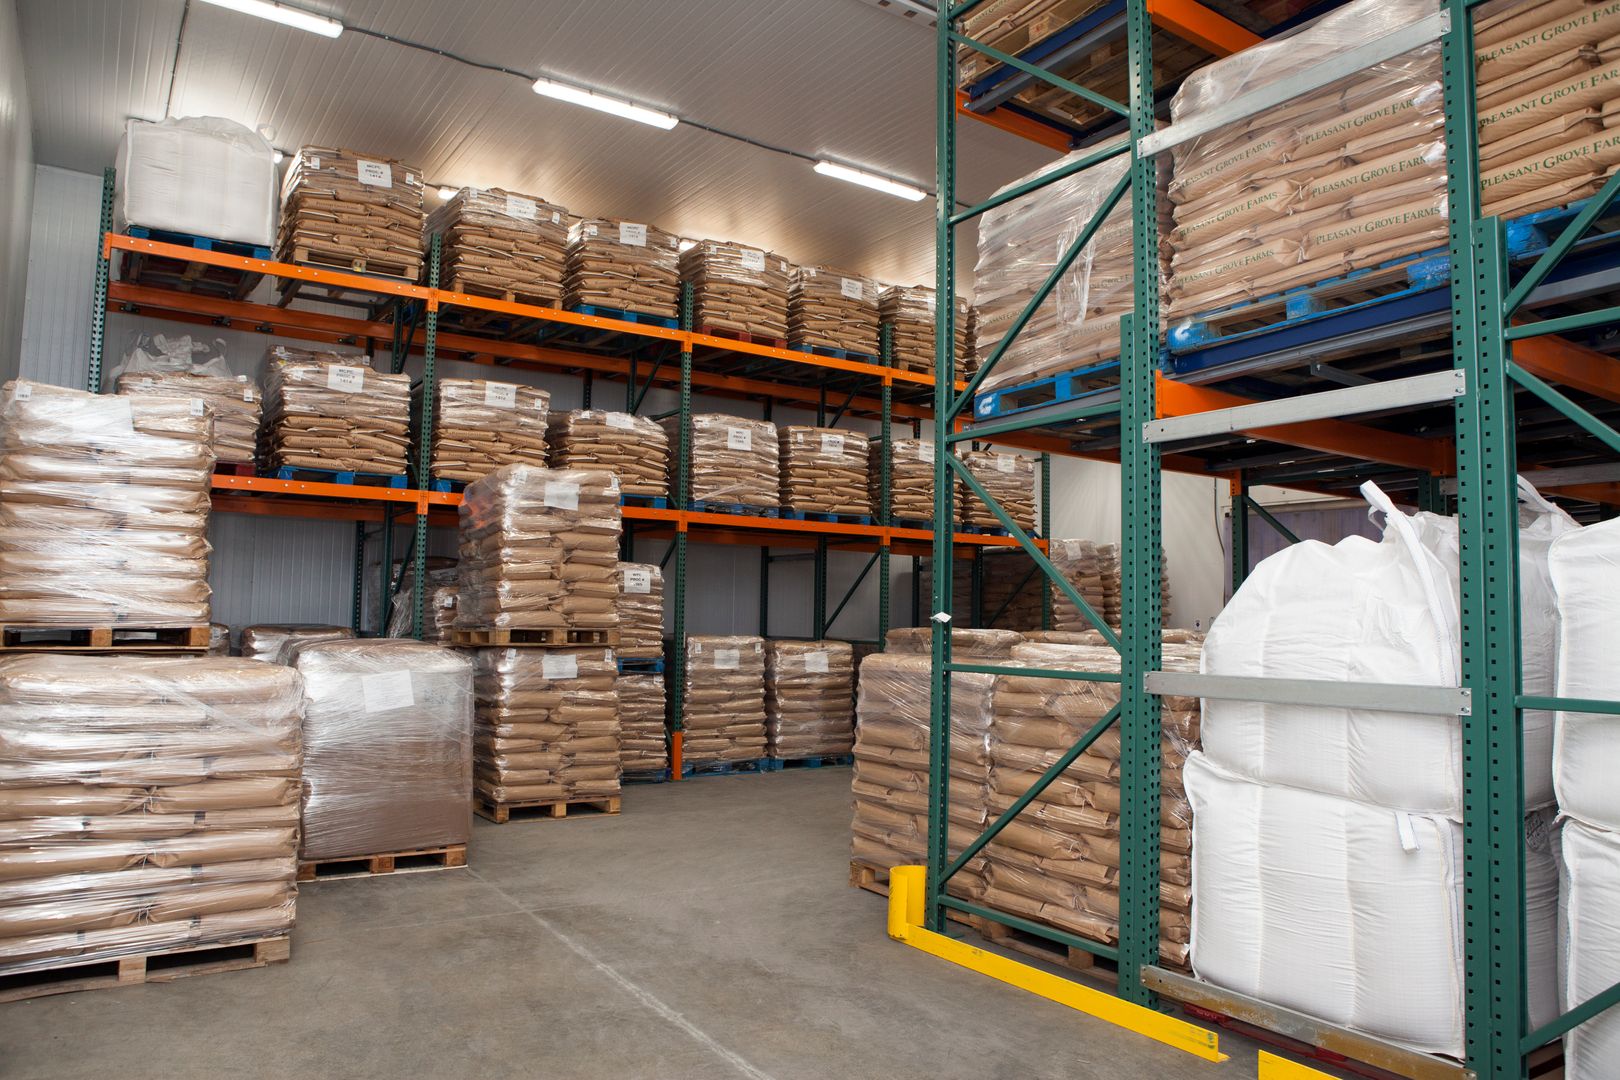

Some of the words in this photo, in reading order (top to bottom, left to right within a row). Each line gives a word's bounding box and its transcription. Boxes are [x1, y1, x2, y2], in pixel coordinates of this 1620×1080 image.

[1479, 34, 1539, 65] PLEASANT
[1541, 15, 1589, 42] GROVE
[1480, 98, 1538, 128] PLEASANT
[1540, 82, 1589, 105] GROVE
[1304, 119, 1353, 144] PLEASANT
[1353, 108, 1390, 127] GROVE
[1215, 152, 1244, 172] GROVE
[1244, 139, 1278, 157] FARMS
[1480, 162, 1540, 191] PLEASANT
[1543, 145, 1590, 169] GROVE
[1312, 175, 1360, 198] PLEASANT
[1360, 163, 1398, 182] GROVE
[1216, 204, 1246, 222] GROVE
[1246, 191, 1278, 210] FARMS
[1315, 225, 1364, 246] PLEASANT
[1364, 215, 1402, 232] GROVE
[1402, 206, 1442, 223] FARMS
[1214, 257, 1244, 275] GROVE
[1244, 248, 1275, 266] FARMS
